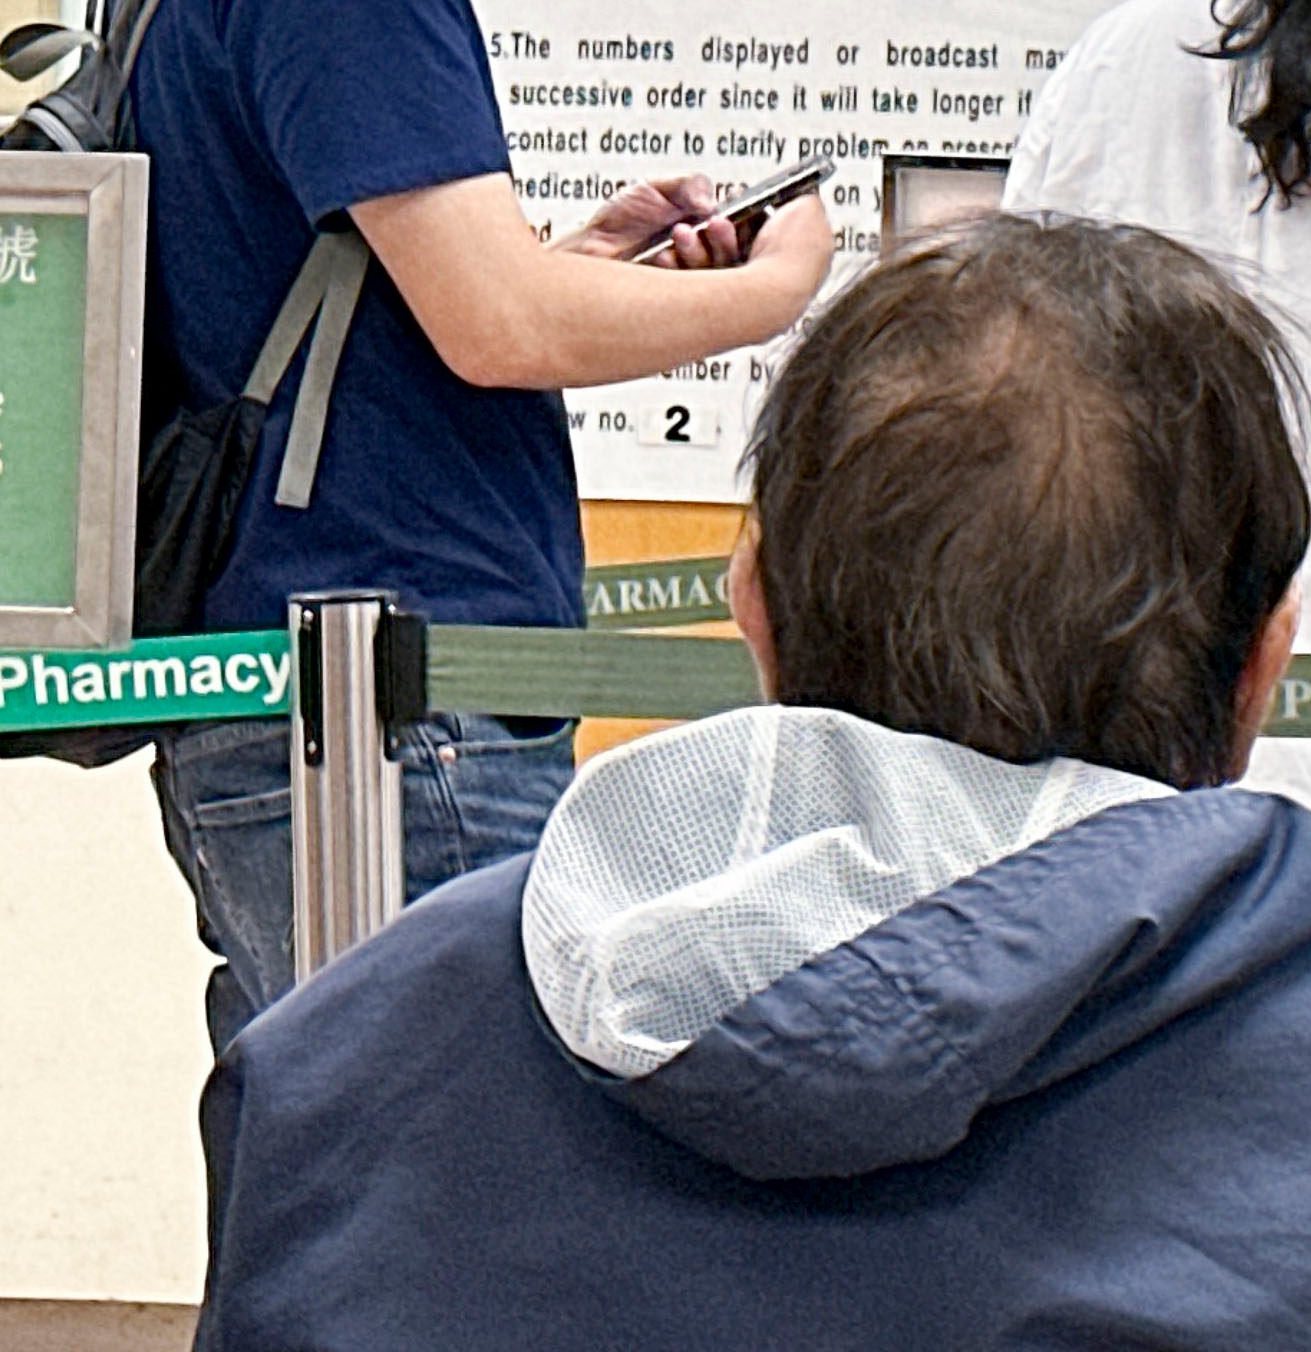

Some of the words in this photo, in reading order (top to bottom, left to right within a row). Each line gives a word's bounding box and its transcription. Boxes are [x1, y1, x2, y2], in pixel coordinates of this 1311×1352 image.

[578, 35, 673, 61] numbers
[702, 37, 808, 70] displayed
[837, 45, 859, 65] or
[887, 40, 997, 68] broadcast
[1025, 43, 1066, 70] ma
[510, 82, 632, 107] successive
[647, 82, 706, 108] order
[720, 83, 778, 110] since
[794, 86, 806, 110] it
[821, 87, 857, 111] will
[873, 88, 918, 113] take
[933, 89, 1004, 122] longer
[1019, 90, 1031, 114] if
[507, 125, 588, 154] contact
[600, 129, 671, 154] doctor
[684, 131, 704, 155] to
[717, 130, 785, 163] clarify
[834, 186, 859, 205] on
[598, 411, 635, 432] no.
[665, 406, 690, 442] 2
[0, 652, 291, 706] Pharmacy
